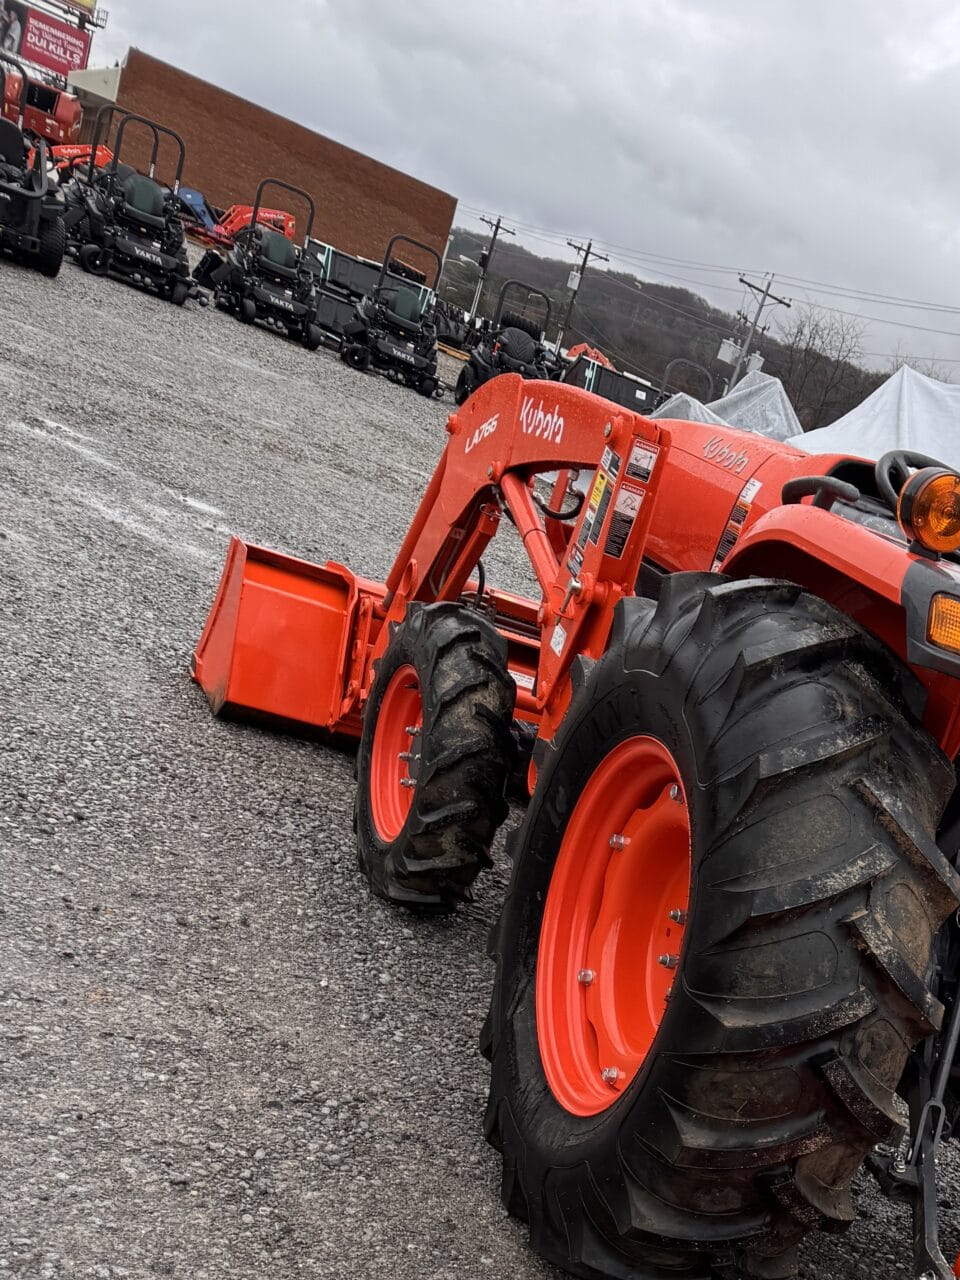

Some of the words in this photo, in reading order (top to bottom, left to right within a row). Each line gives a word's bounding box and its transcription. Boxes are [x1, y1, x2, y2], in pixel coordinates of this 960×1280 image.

[27, 32, 47, 48] DUI
[48, 43, 80, 64] KILLS
[29, 17, 84, 48] REMEMBERING
[520, 396, 564, 444] Kubota
[703, 435, 749, 474] Kubota
